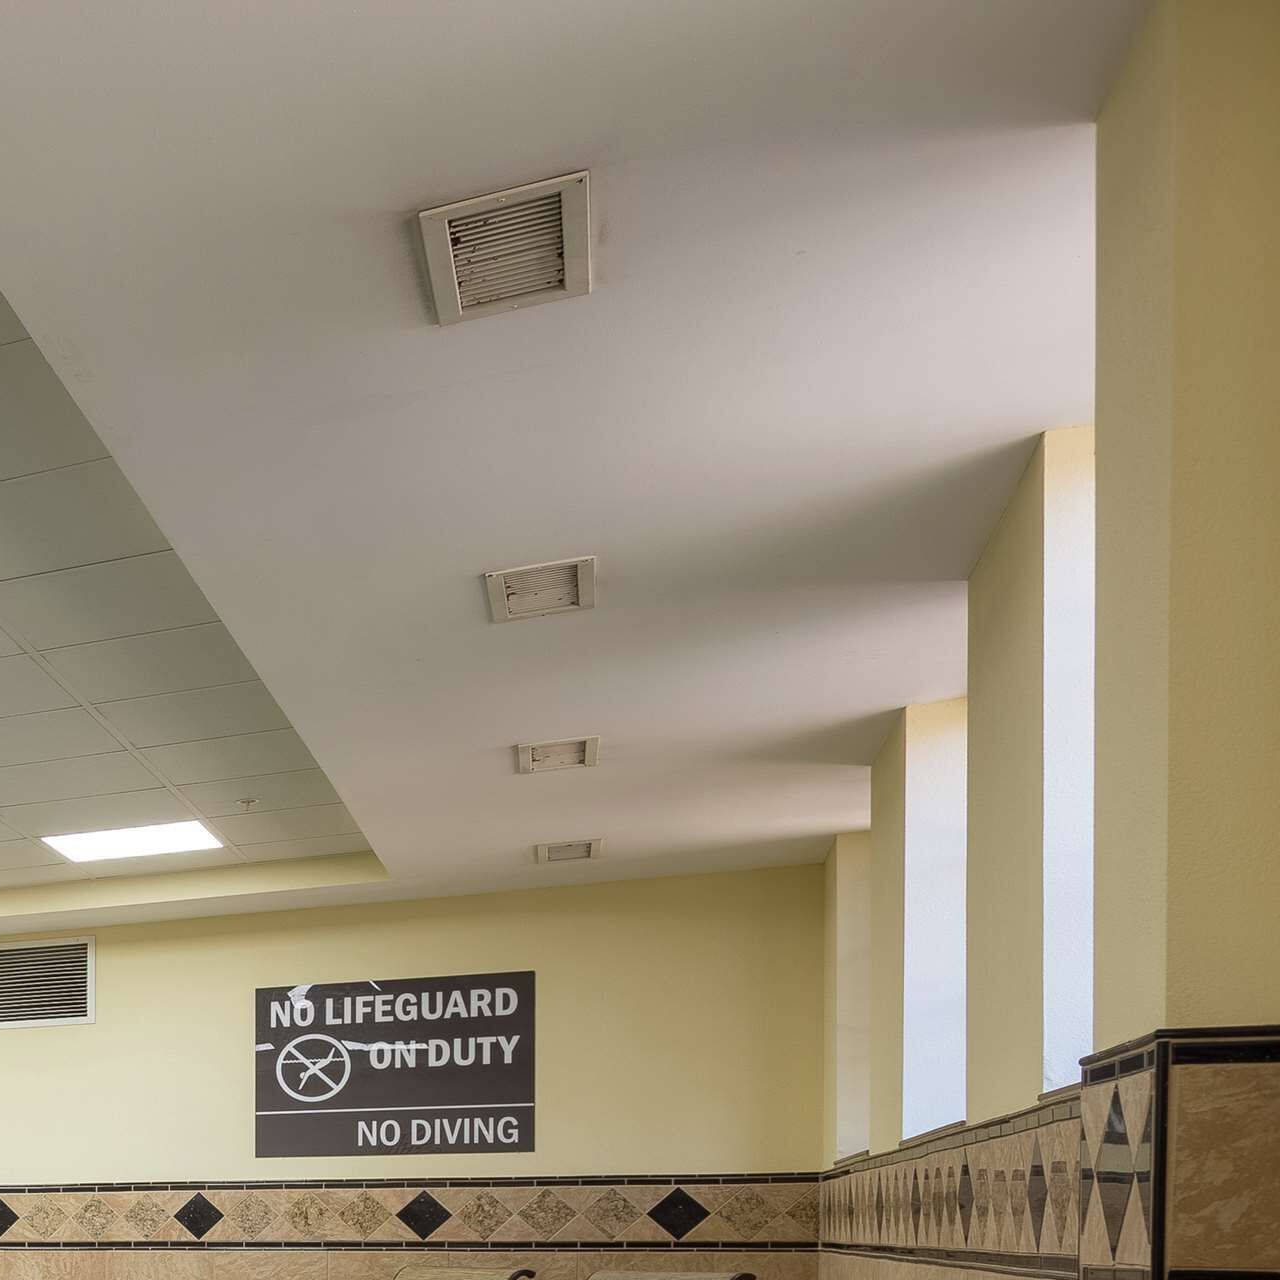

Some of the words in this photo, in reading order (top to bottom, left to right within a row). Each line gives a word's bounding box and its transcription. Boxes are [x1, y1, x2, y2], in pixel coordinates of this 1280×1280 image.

[270, 999, 315, 1028] NO
[325, 987, 519, 1026] LIFEGUARD
[369, 1042, 416, 1070] ON
[428, 1035, 521, 1067] DUTY
[358, 1119, 401, 1146] NO
[411, 1116, 519, 1145] DIVING
